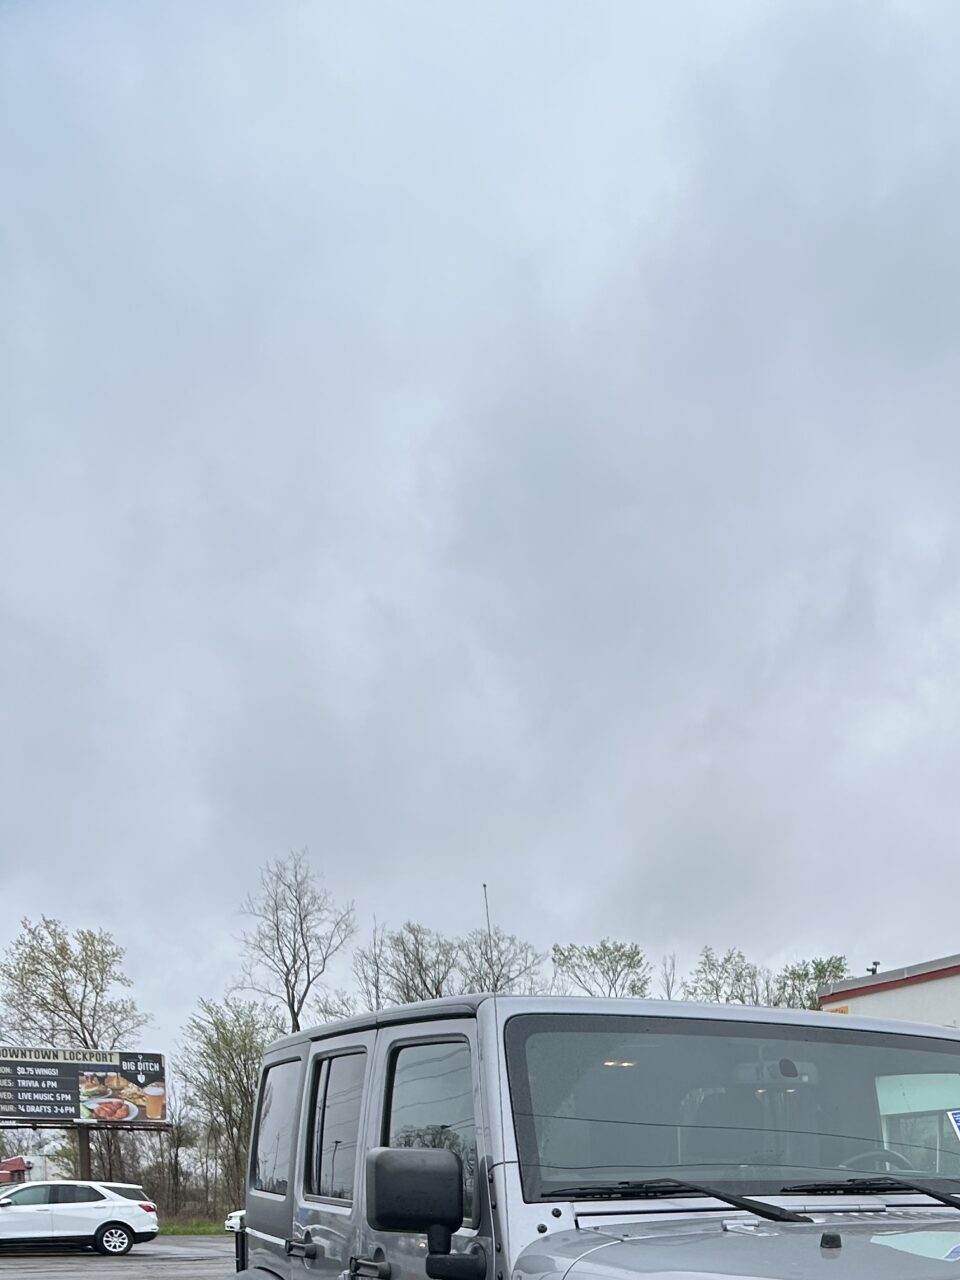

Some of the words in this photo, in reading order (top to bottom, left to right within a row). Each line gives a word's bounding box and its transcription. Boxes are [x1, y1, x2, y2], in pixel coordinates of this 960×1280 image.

[0, 1048, 59, 1060] OWNTOWN
[63, 1051, 114, 1062] LOCKPORT
[122, 1061, 136, 1071] BIG
[137, 1061, 160, 1072] DITCH
[0, 1079, 14, 1087] UES:
[17, 1080, 39, 1088] TRIVIA
[18, 1092, 32, 1100] LIVE
[33, 1093, 55, 1101] MUSIC
[26, 1105, 52, 1113] DRAFTS
